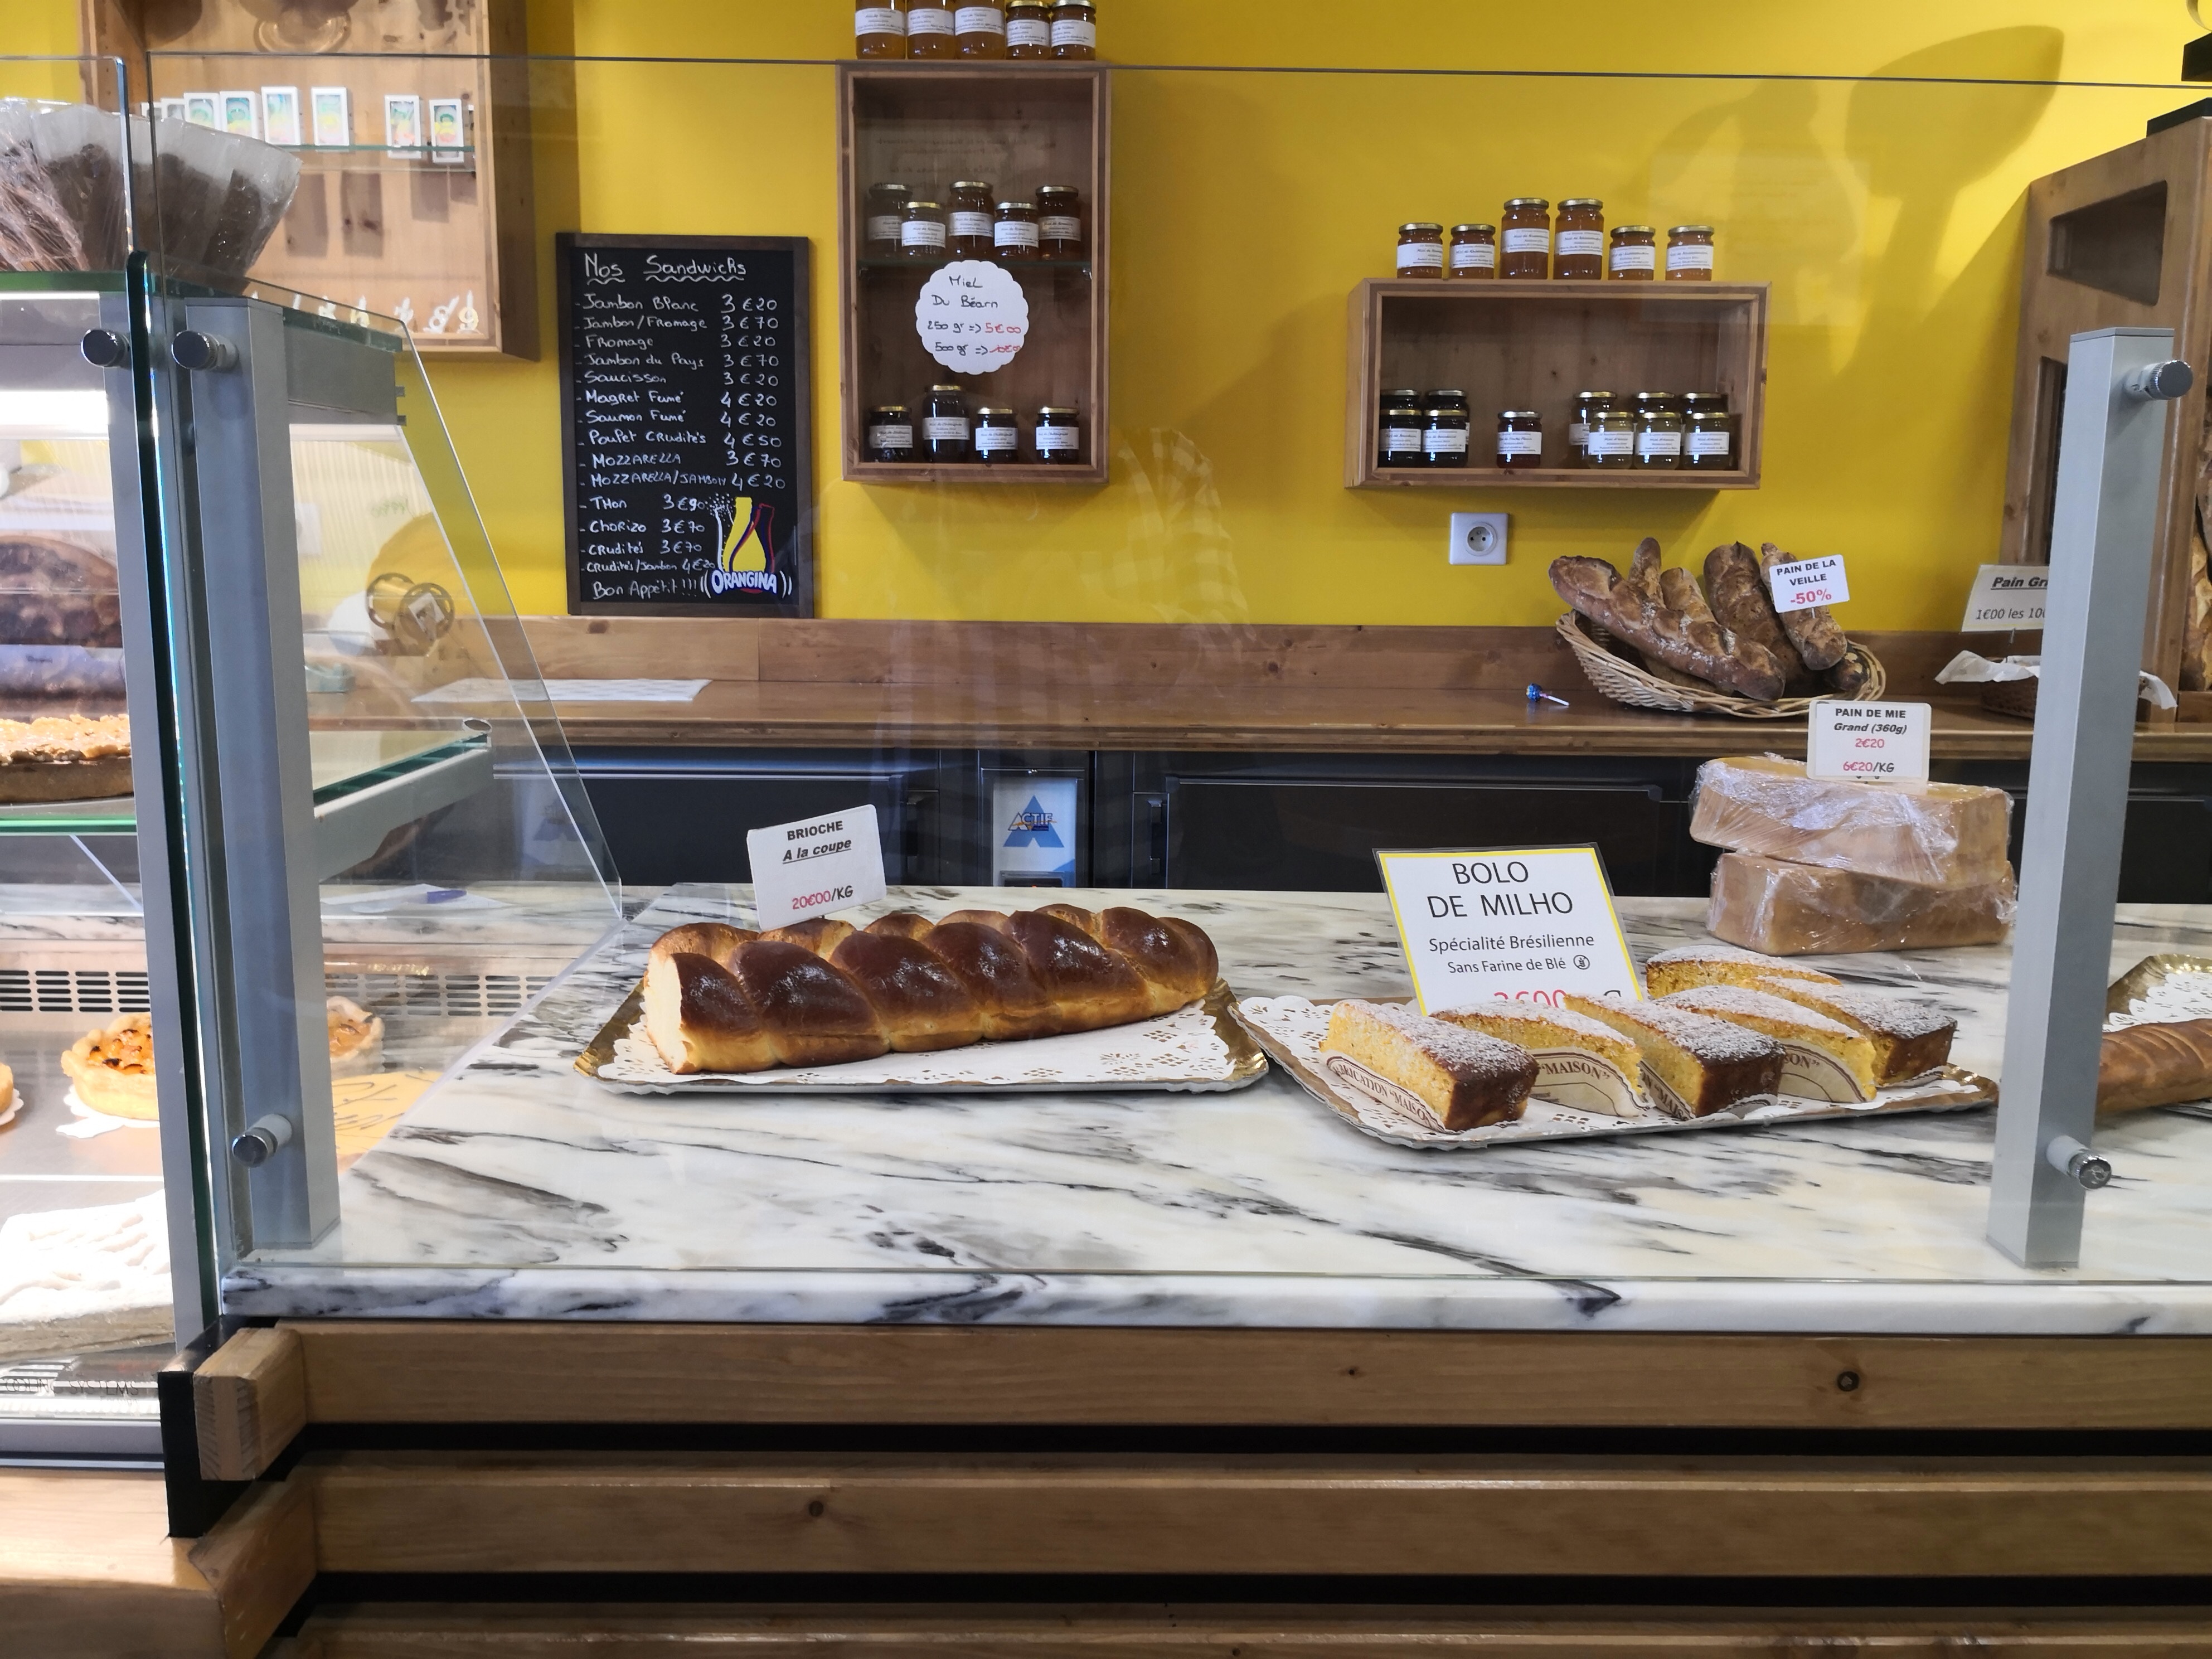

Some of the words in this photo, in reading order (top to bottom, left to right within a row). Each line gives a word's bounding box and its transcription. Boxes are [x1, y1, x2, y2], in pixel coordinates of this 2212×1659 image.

[585, 253, 623, 278] Nos
[643, 255, 746, 275] Sandwichs
[583, 293, 643, 309] Jambon
[653, 296, 698, 312] Blanc
[931, 294, 950, 306] Du
[961, 295, 998, 308] Béarn
[927, 321, 949, 330] 250
[935, 342, 954, 352] 500
[584, 353, 640, 366] Jambon
[646, 354, 662, 366] du
[672, 352, 705, 371] Pays
[584, 370, 666, 384] Saucisson
[649, 391, 684, 404] Fumé
[586, 409, 643, 423] Saumon
[651, 409, 687, 423] Fumé
[589, 429, 637, 445] Poulet
[1777, 565, 1802, 576] PAIN
[1805, 562, 1820, 571] DE
[1822, 559, 1836, 567] LA
[1789, 573, 1827, 586] VEILLE
[1992, 576, 2024, 588] Pain
[593, 580, 624, 600] Bon
[1790, 588, 1832, 604] -50%
[2008, 608, 2024, 619] les
[2028, 608, 2045, 619] 10
[1835, 708, 1862, 717] PAIN
[1866, 709, 1881, 717] DE
[1885, 710, 1906, 719] MIE
[1833, 722, 1869, 732] Grand
[1871, 724, 1907, 735] (360g)
[1855, 738, 1885, 748] 2€20
[1843, 761, 1895, 773] 6€20/KG
[1008, 812, 1053, 831] ACTIF
[787, 821, 843, 841] BRIOCHE
[783, 850, 792, 861] A
[797, 847, 808, 858] la
[813, 840, 852, 855] coupe
[1451, 861, 1529, 885] BOLO
[792, 885, 853, 910] 20€00/KG
[1427, 895, 1467, 918] DE
[1480, 891, 1573, 917] MILHO
[1429, 936, 1505, 954] Spécialité
[1510, 933, 1594, 949] Brésilienne
[1448, 961, 1479, 973] Sans
[1483, 959, 1523, 972] Farine
[1526, 958, 1542, 971] de
[1546, 957, 1566, 969] Blé
